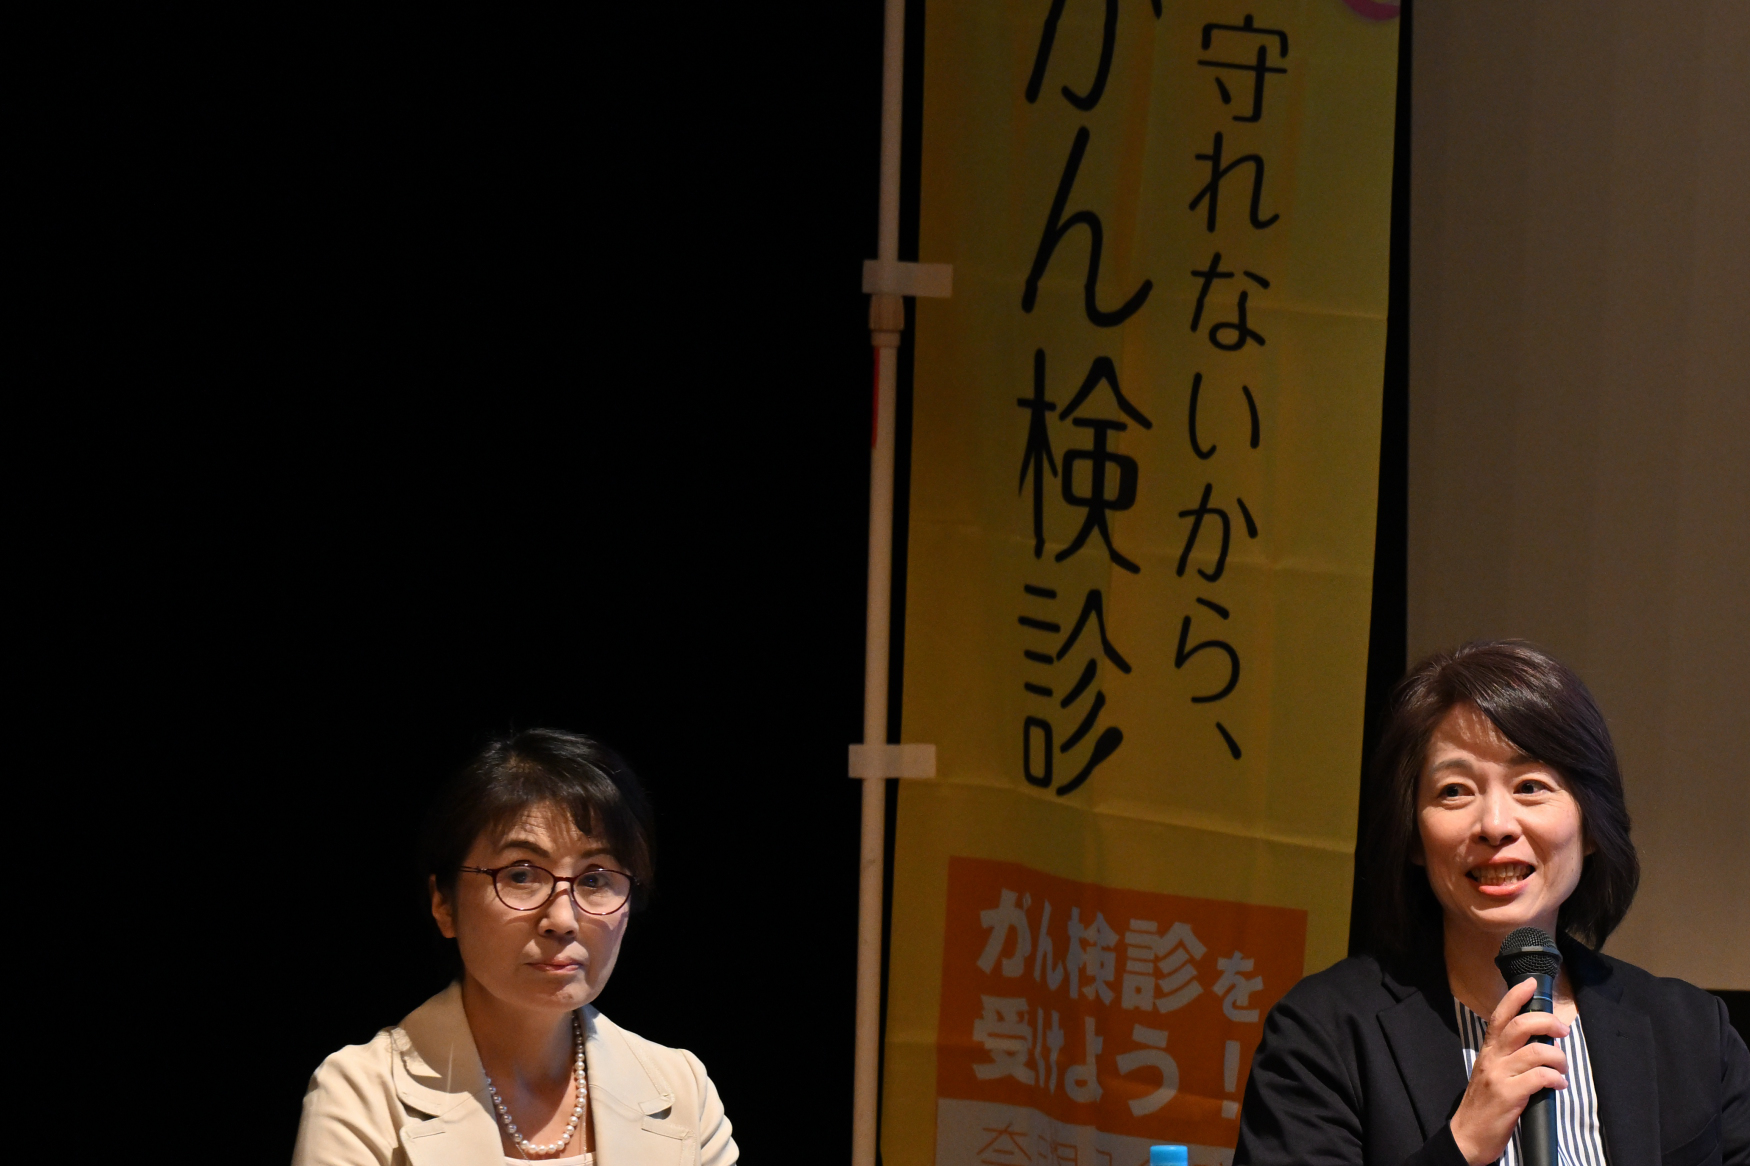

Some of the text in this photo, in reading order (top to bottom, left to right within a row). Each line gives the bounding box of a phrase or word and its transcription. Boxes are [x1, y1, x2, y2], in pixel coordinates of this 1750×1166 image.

[1175, 14, 1289, 760] 守れないから、
[976, 887, 1266, 1024] がん検診を
[972, 994, 1242, 1120] 受けよう！
